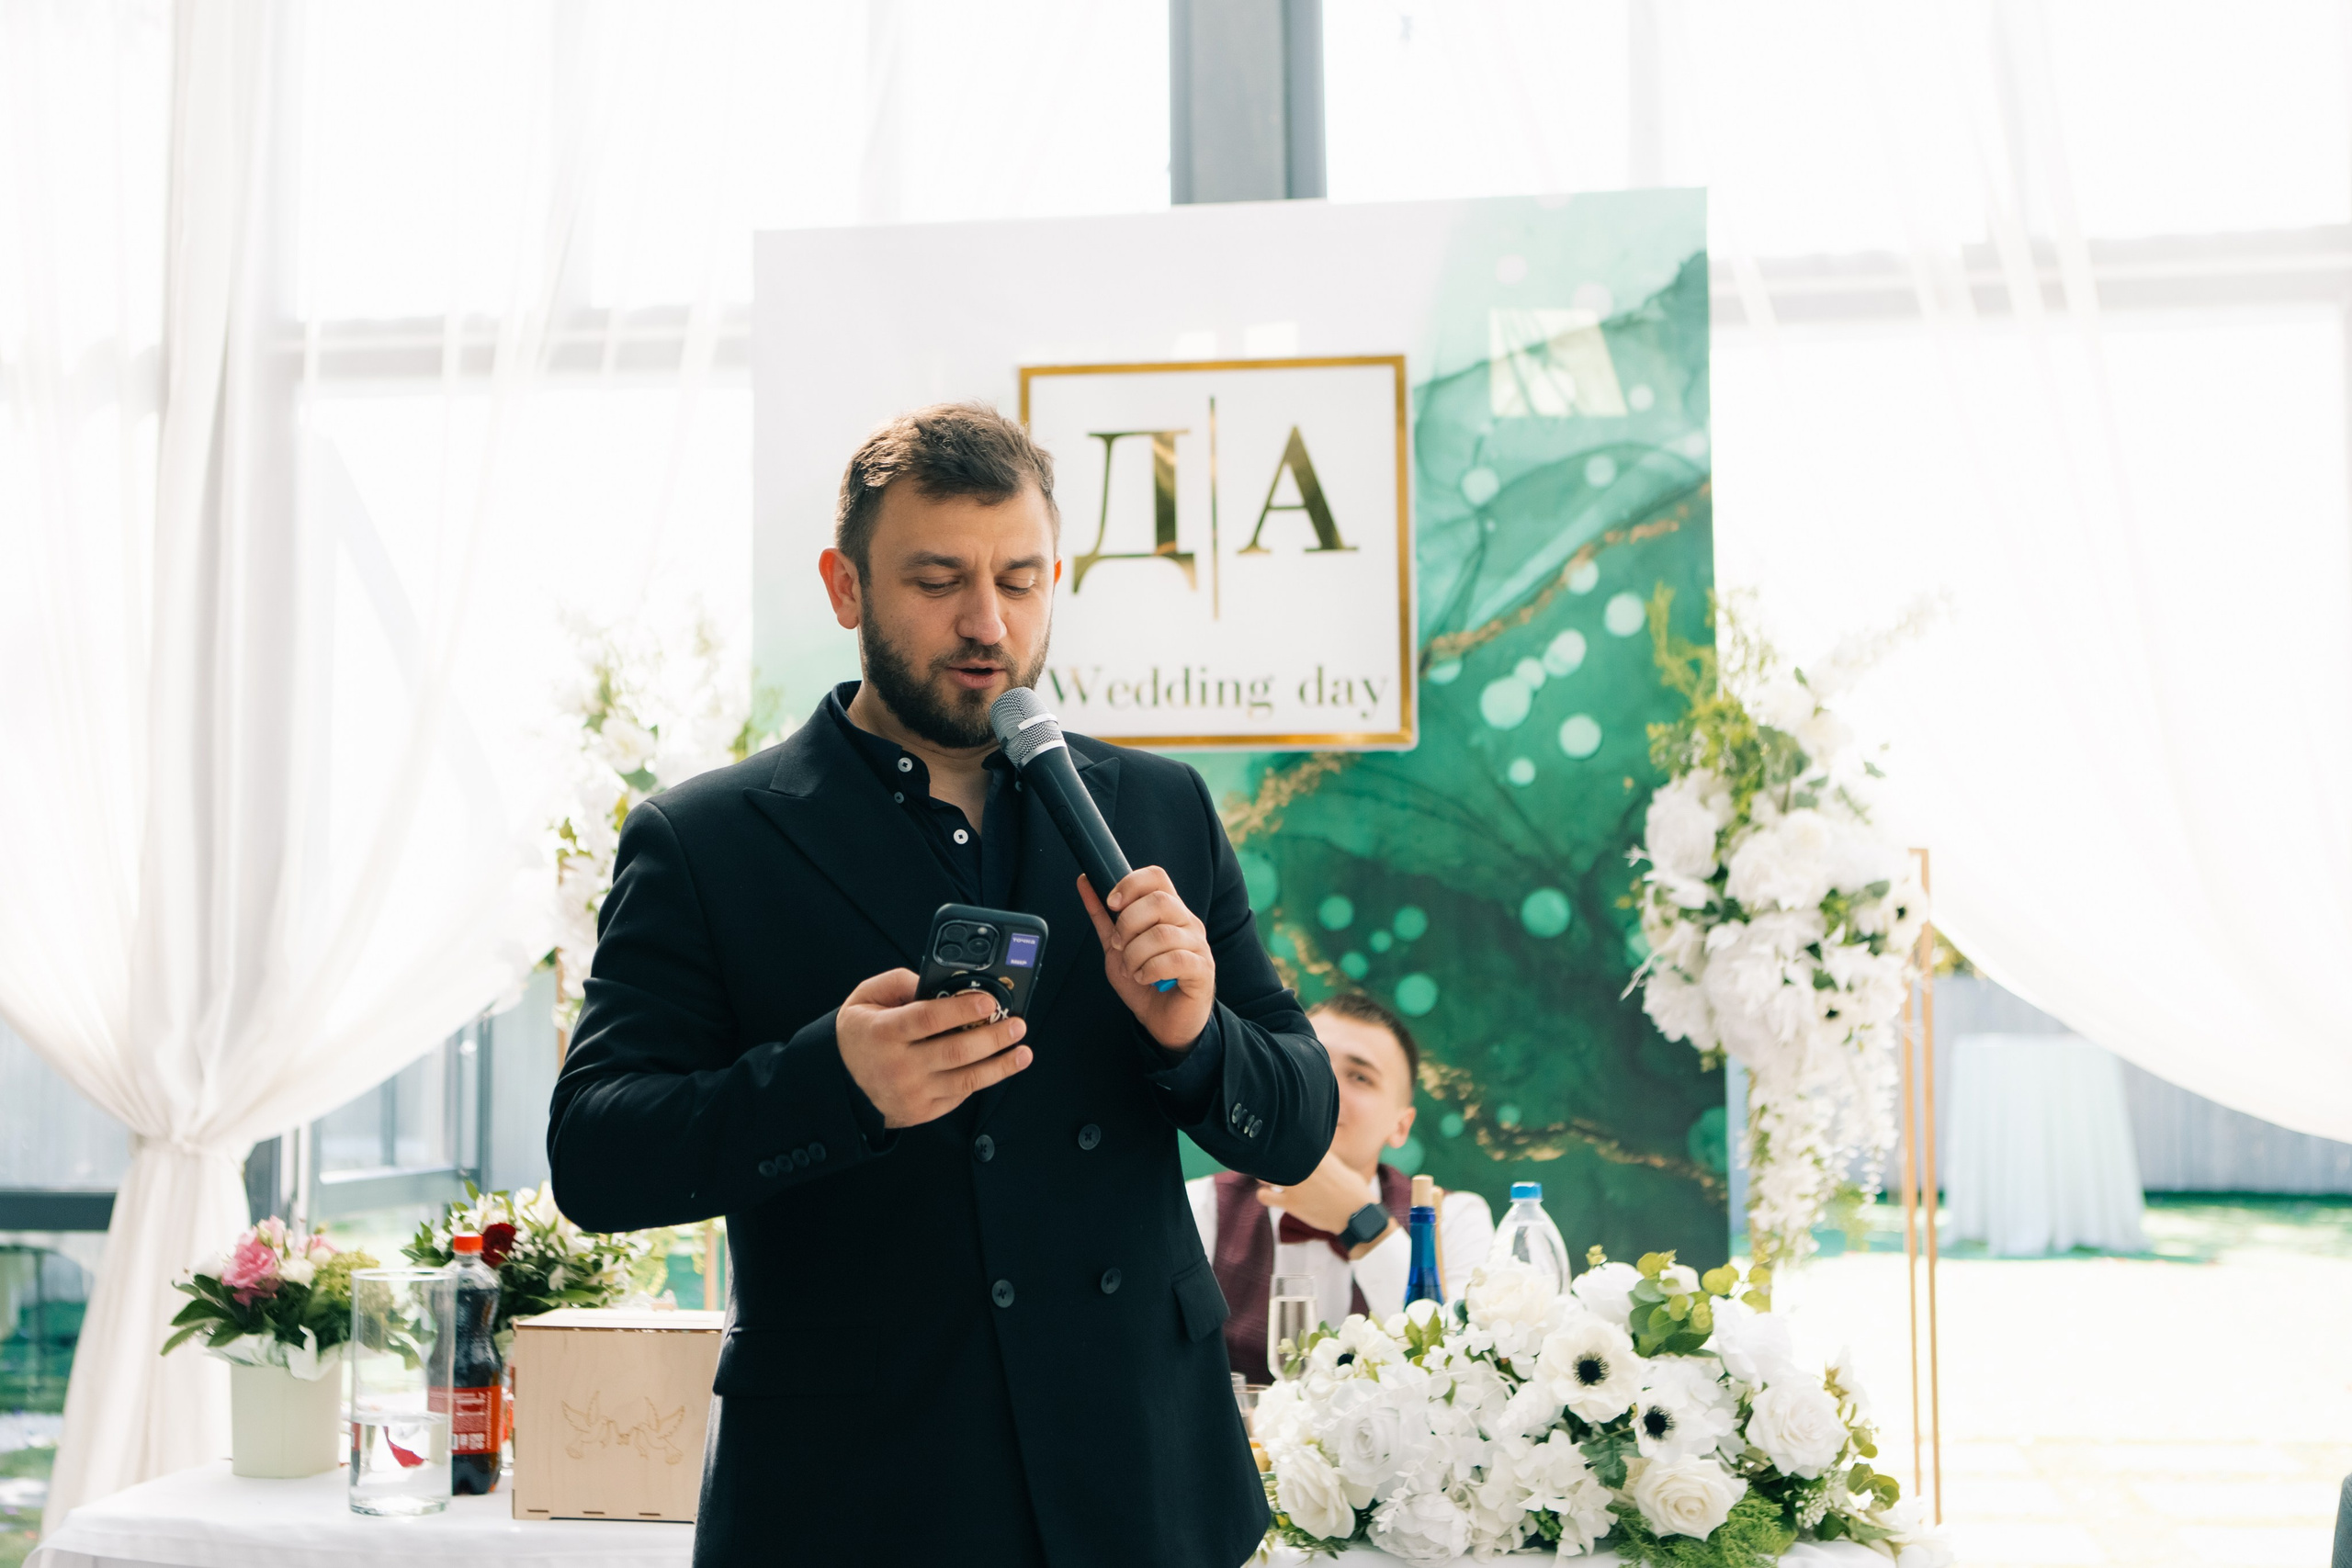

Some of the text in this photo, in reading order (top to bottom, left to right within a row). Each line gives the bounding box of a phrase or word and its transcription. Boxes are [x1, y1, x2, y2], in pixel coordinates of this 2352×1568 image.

[1071, 429, 1198, 595] Д
[1048, 664, 1389, 719] Wedding day
